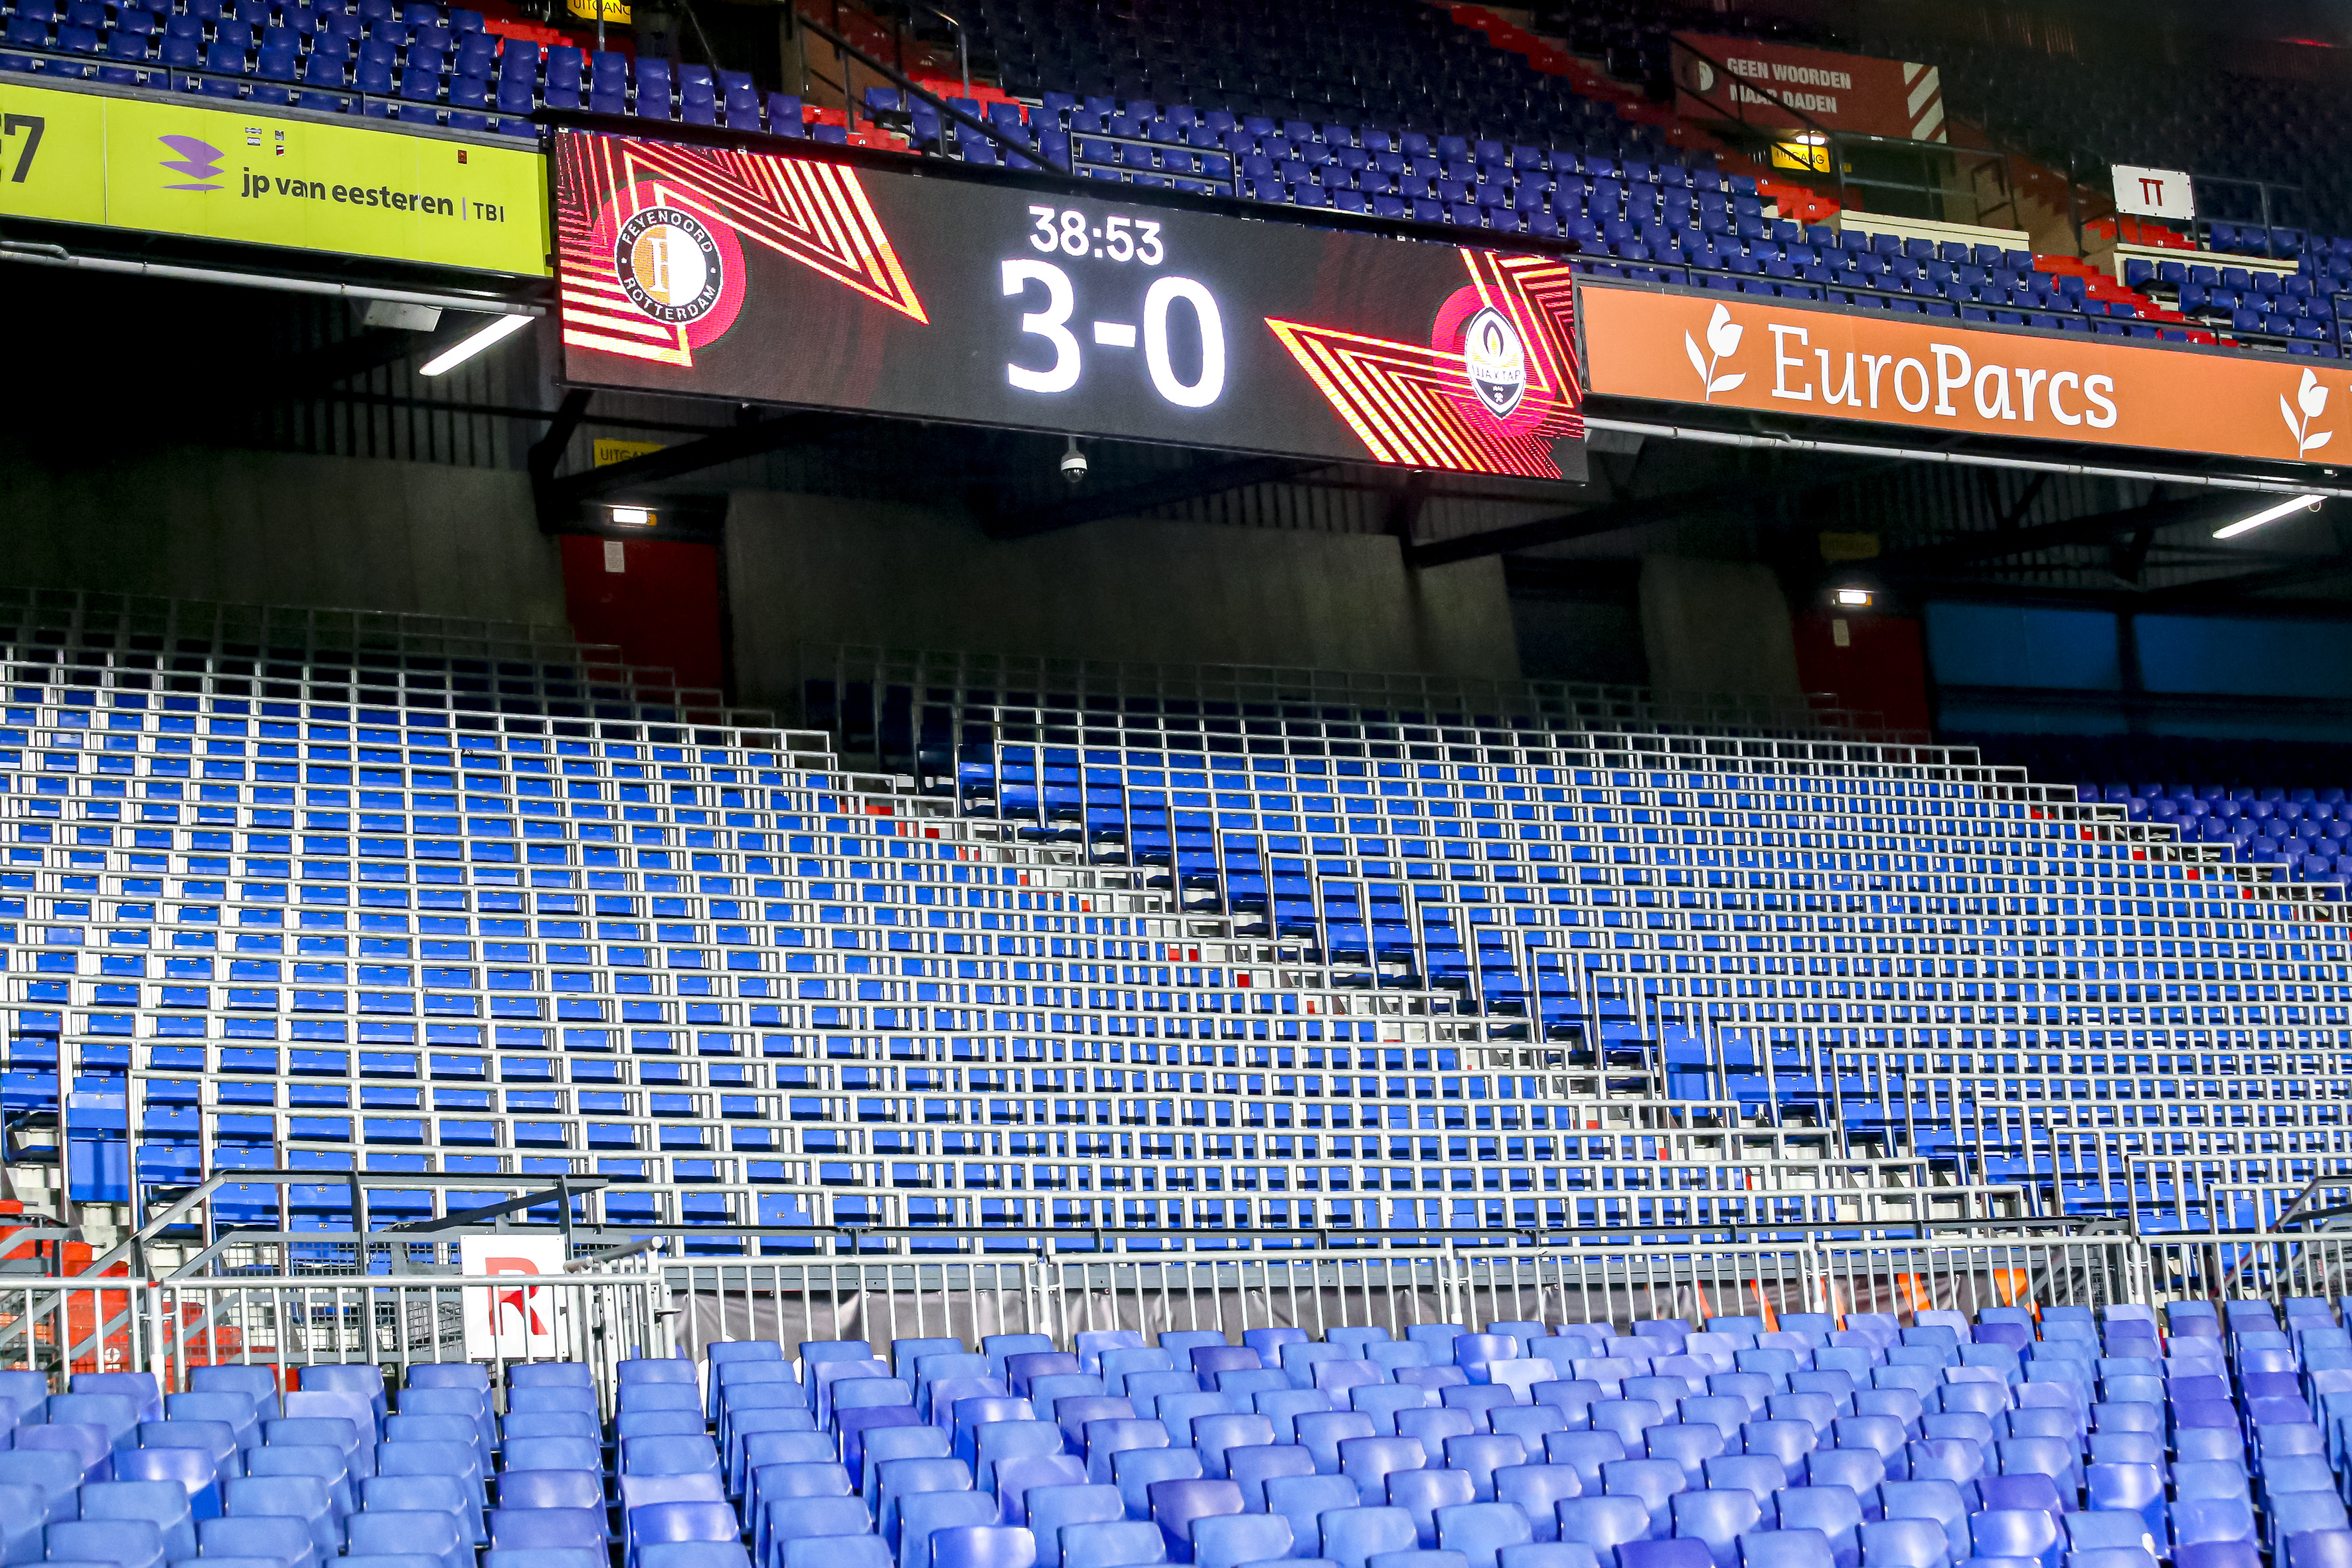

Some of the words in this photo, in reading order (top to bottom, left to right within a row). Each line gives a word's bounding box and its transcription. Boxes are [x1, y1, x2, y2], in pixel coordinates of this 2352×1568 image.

[1727, 58, 1768, 79] GEEN
[1772, 63, 1851, 90] WOORDEN
[1783, 90, 1838, 114] DADEN
[0, 113, 44, 183] 7
[241, 167, 270, 198] jp
[275, 176, 325, 200] van
[331, 184, 453, 216] eesteren
[473, 202, 505, 222] TBI
[2138, 178, 2163, 206] TT
[622, 210, 713, 253] FEYENOORD
[1028, 204, 1164, 266] 38:53
[623, 277, 716, 321] ROTTERDAM
[1000, 258, 1225, 408] 3-0
[1767, 323, 2118, 429] EuroParcs
[600, 447, 644, 462] UITGA
[485, 1257, 549, 1336] R
